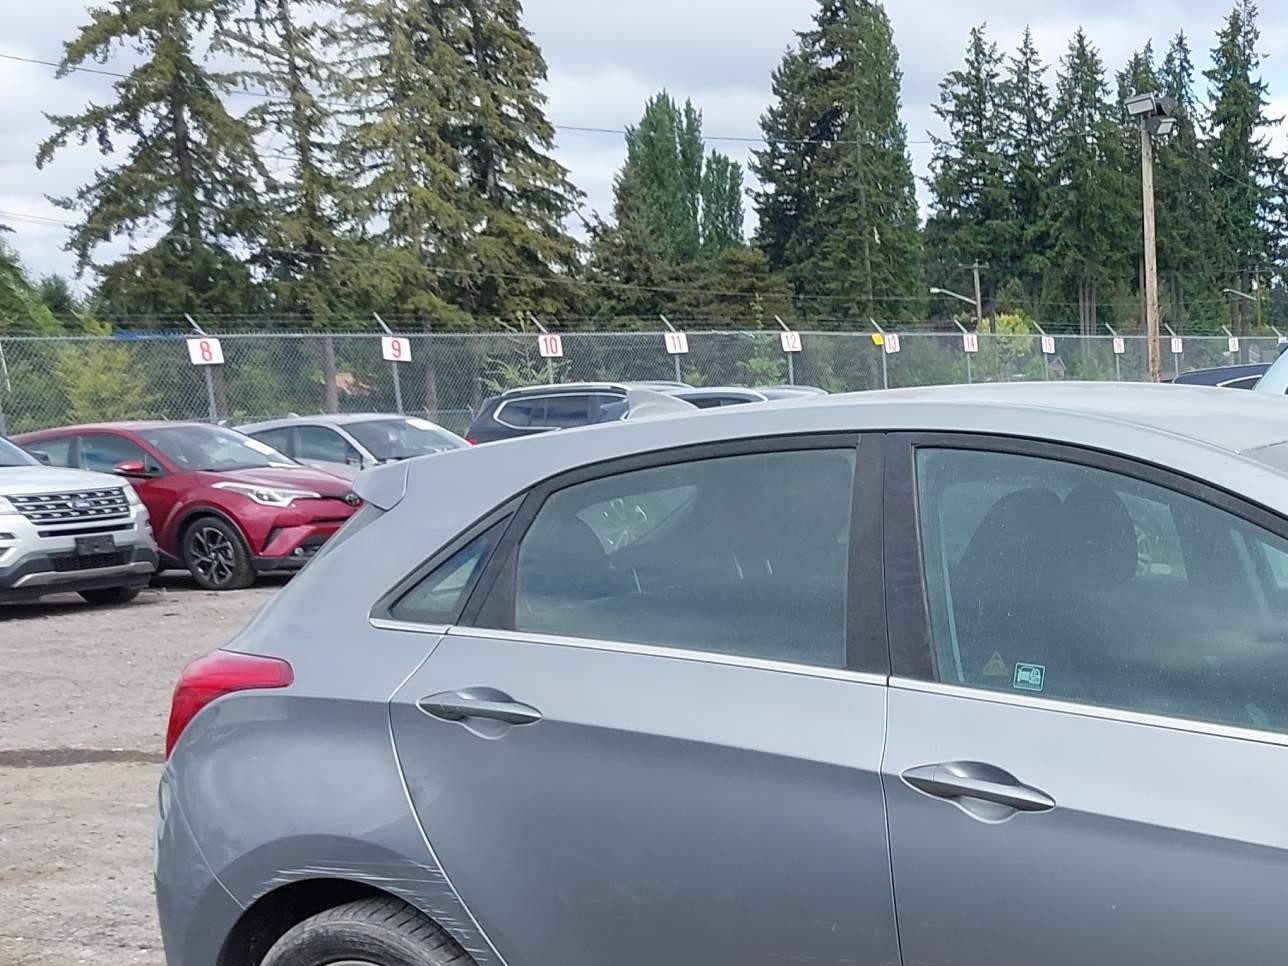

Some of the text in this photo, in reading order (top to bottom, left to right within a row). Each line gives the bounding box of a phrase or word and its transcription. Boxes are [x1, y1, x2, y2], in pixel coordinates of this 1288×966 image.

[391, 339, 402, 359] 9
[543, 336, 558, 355] 10
[671, 335, 682, 352] 11
[785, 334, 797, 350] 12
[887, 335, 897, 351] 13
[200, 341, 213, 362] 8
